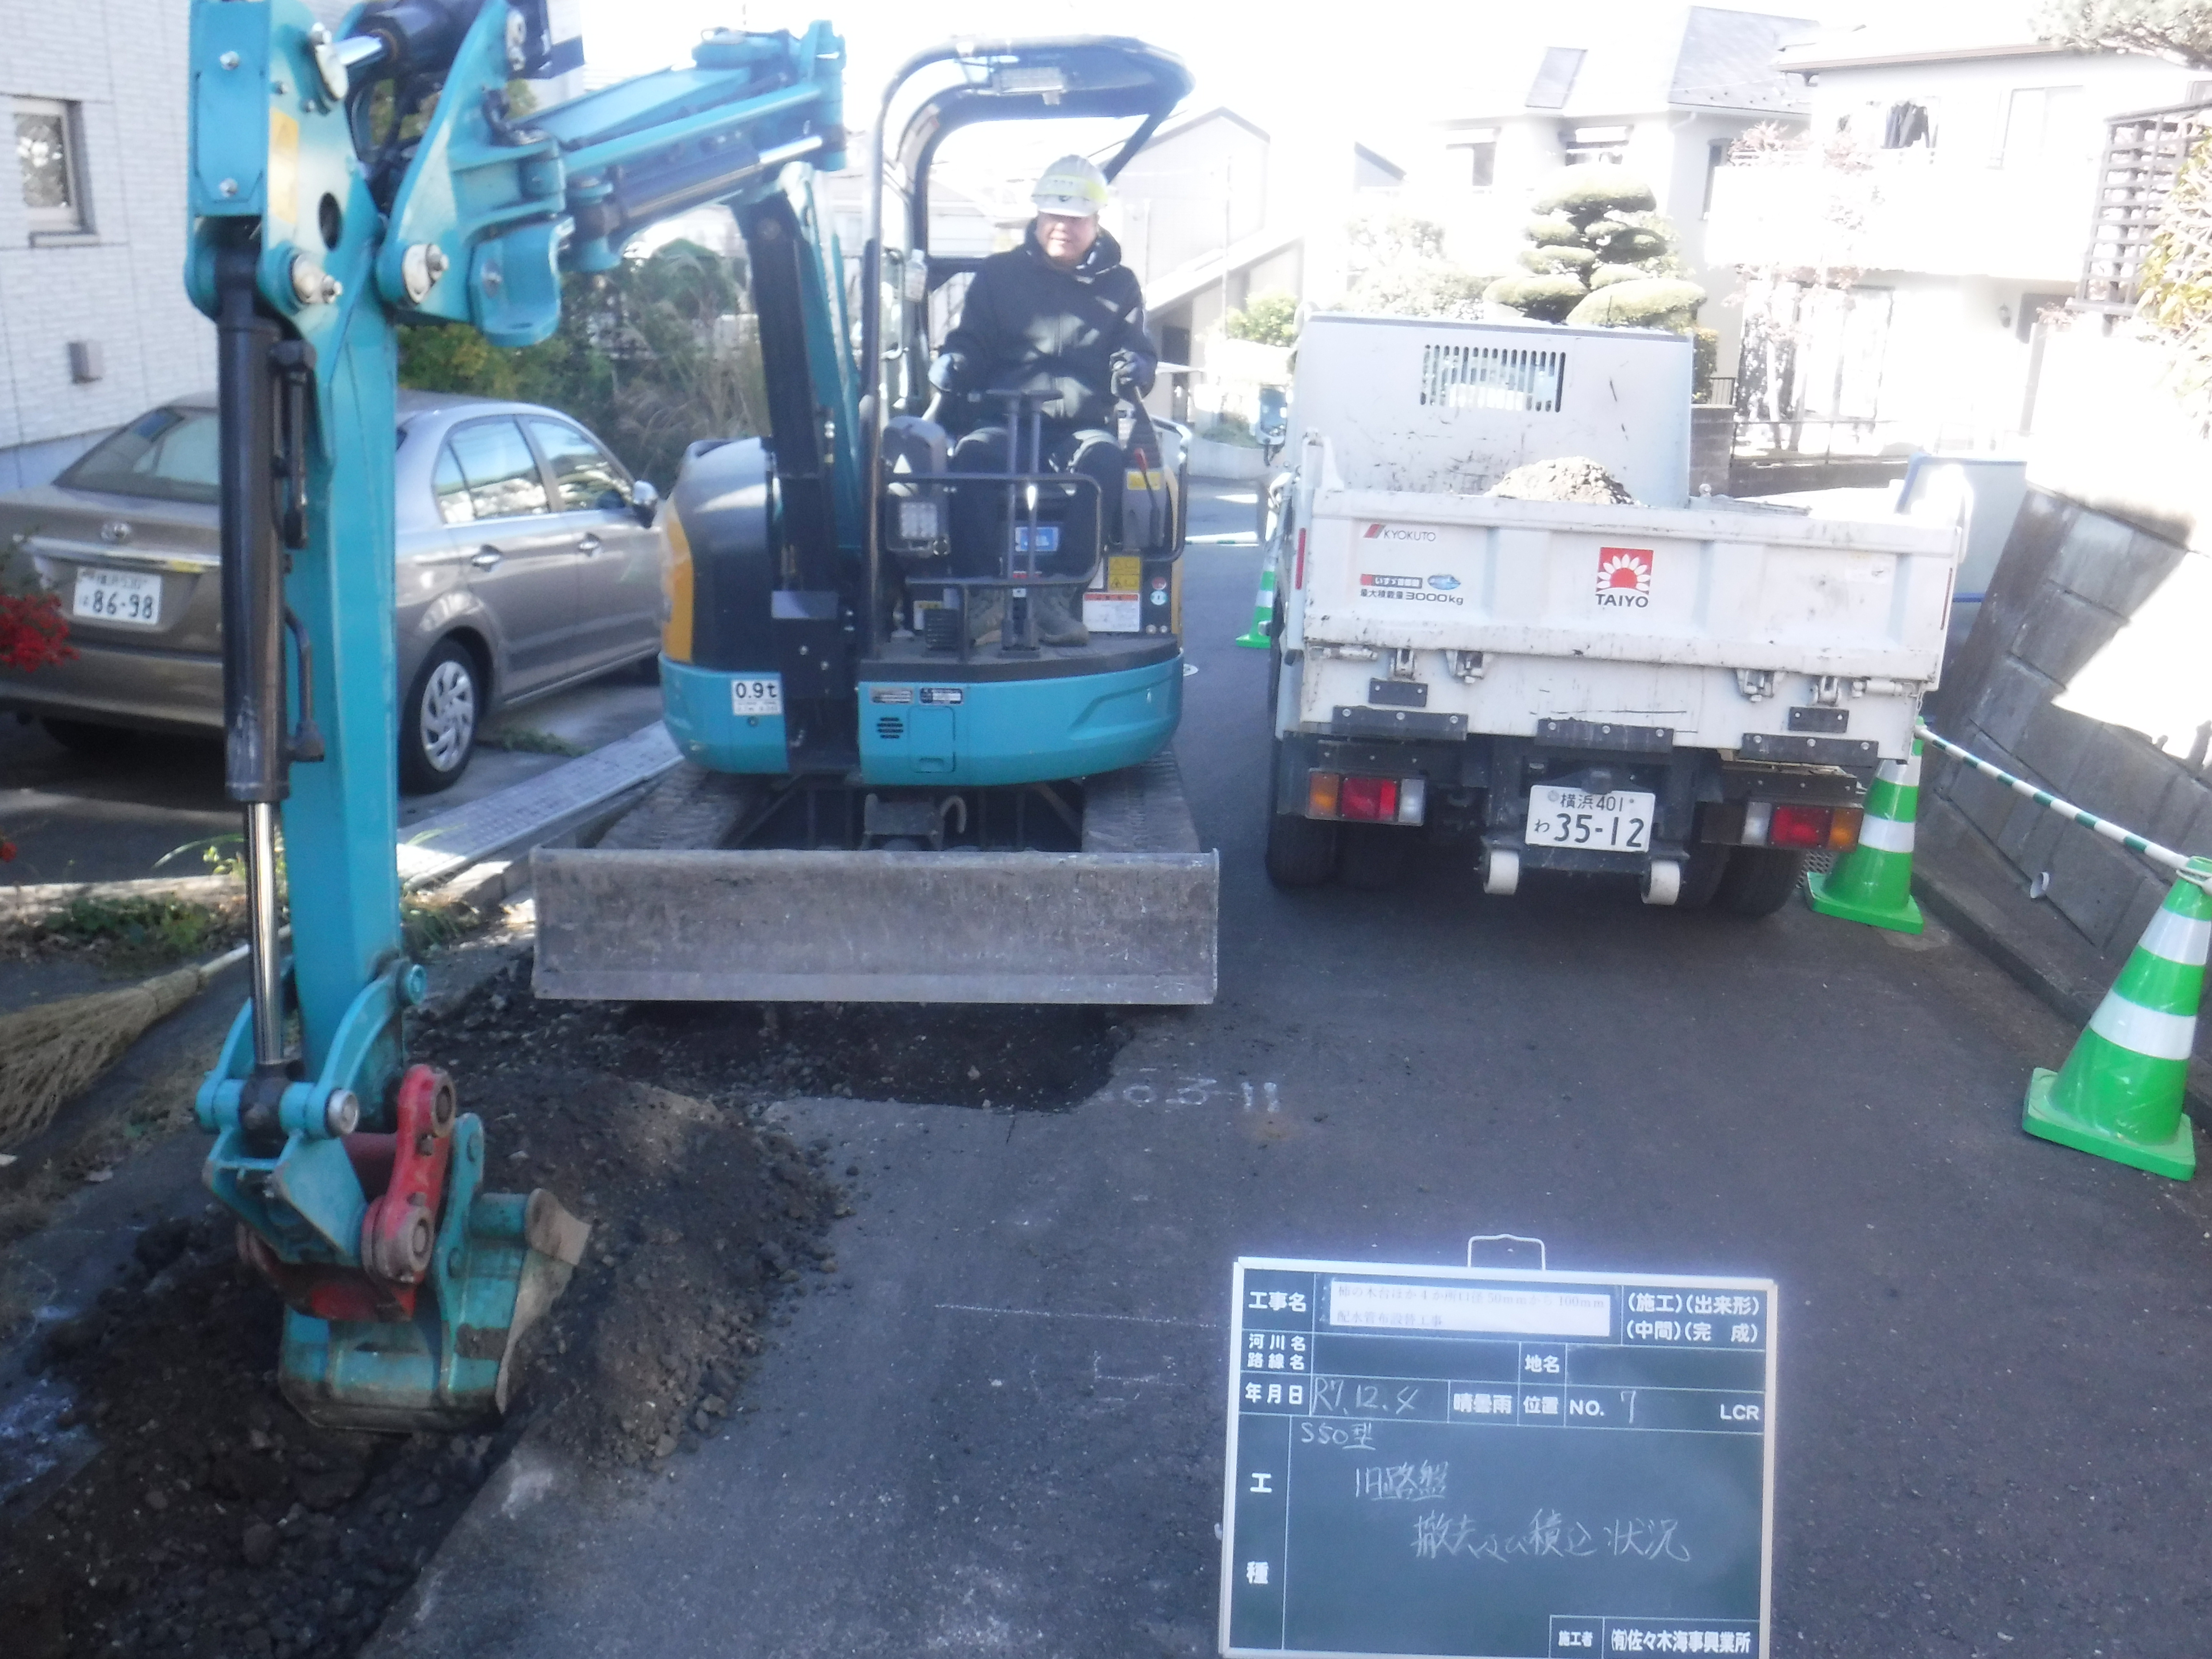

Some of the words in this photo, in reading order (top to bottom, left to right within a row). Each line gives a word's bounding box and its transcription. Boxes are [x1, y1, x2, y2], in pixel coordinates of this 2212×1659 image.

[1383, 529, 1437, 542] KYOKUTO
[1595, 593, 1649, 608] TAIYO
[1534, 819, 1551, 833] わ
[1553, 812, 1645, 848] 35-12
[1248, 1291, 1307, 1312] 工事名
[1249, 1333, 1306, 1352] 河川名
[1247, 1352, 1305, 1370] 路線名
[1524, 1354, 1560, 1373] 地名
[1245, 1382, 1303, 1406] 年月日
[1523, 1395, 1559, 1415] 位置
[1569, 1399, 1605, 1417] NO.
[1620, 1390, 1637, 1424] 7
[1719, 1403, 1760, 1421] LCR
[1558, 1630, 1594, 1648] 施工者
